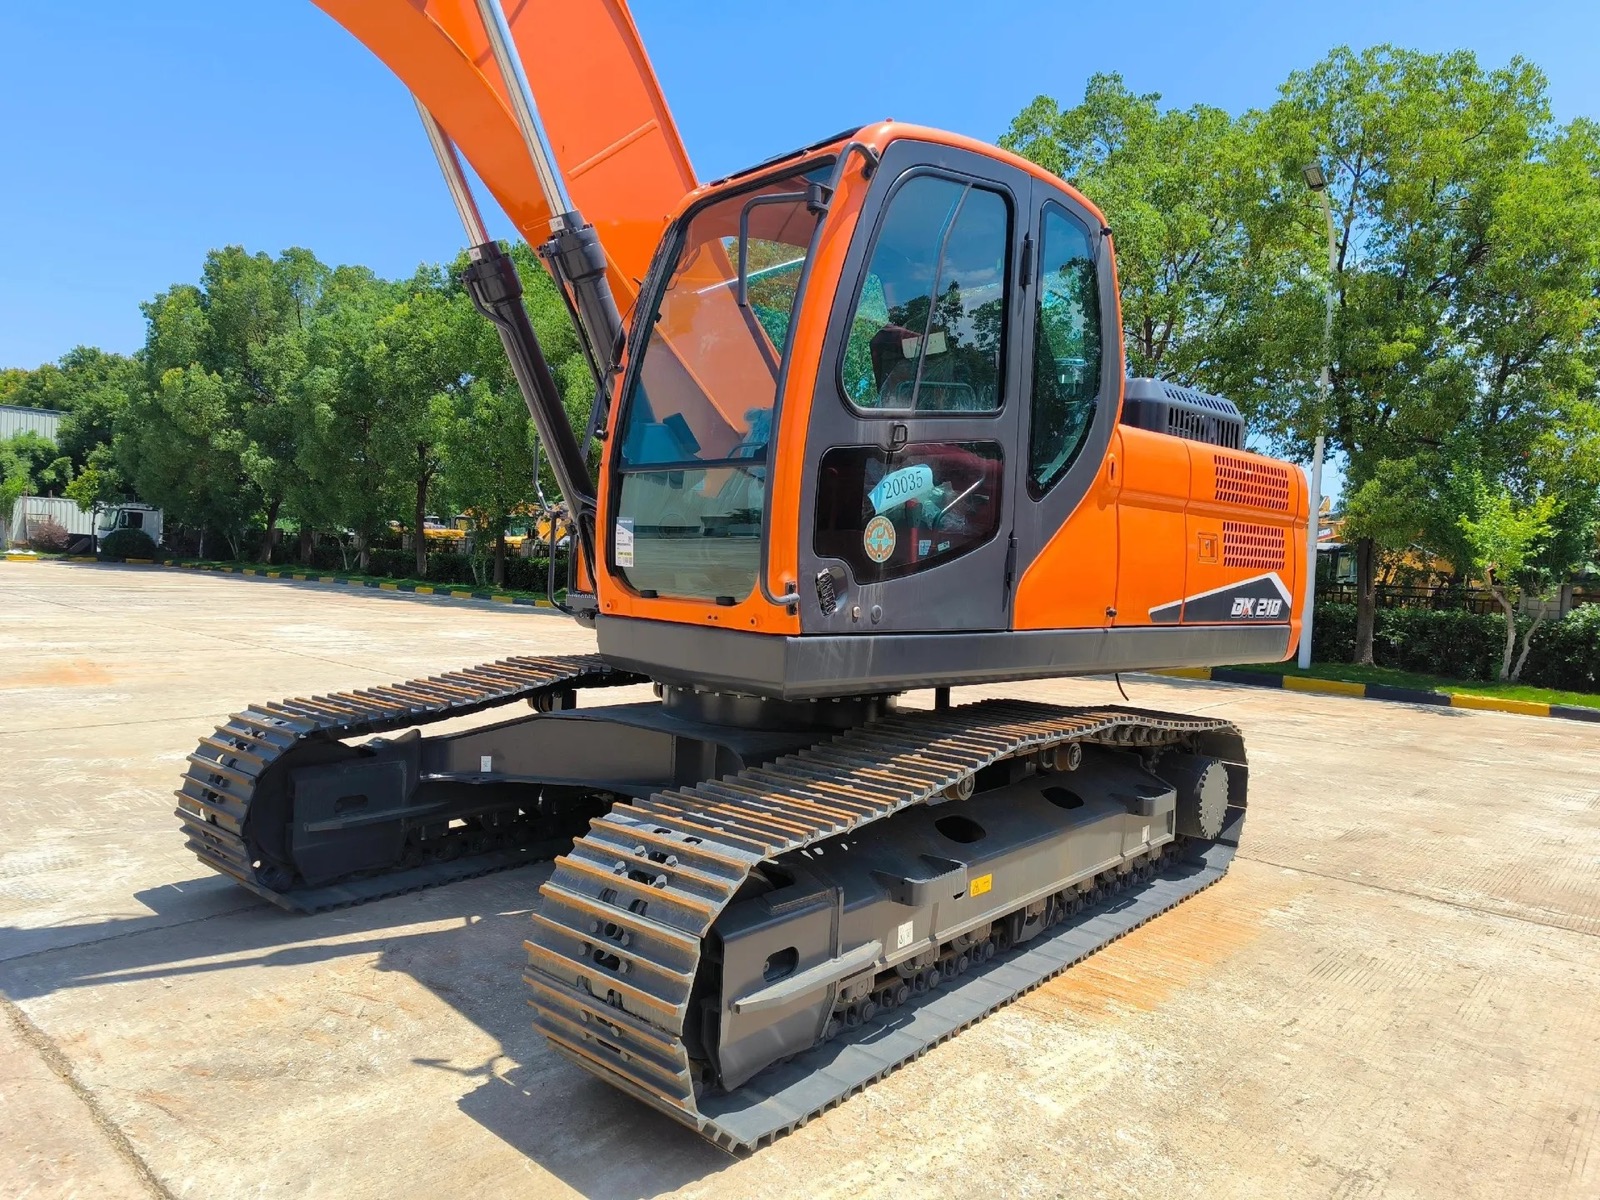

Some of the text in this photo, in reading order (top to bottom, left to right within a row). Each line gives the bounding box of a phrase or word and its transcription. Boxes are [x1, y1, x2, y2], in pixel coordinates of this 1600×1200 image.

[882, 470, 923, 500] 20035
[1230, 597, 1282, 618] DX 210
